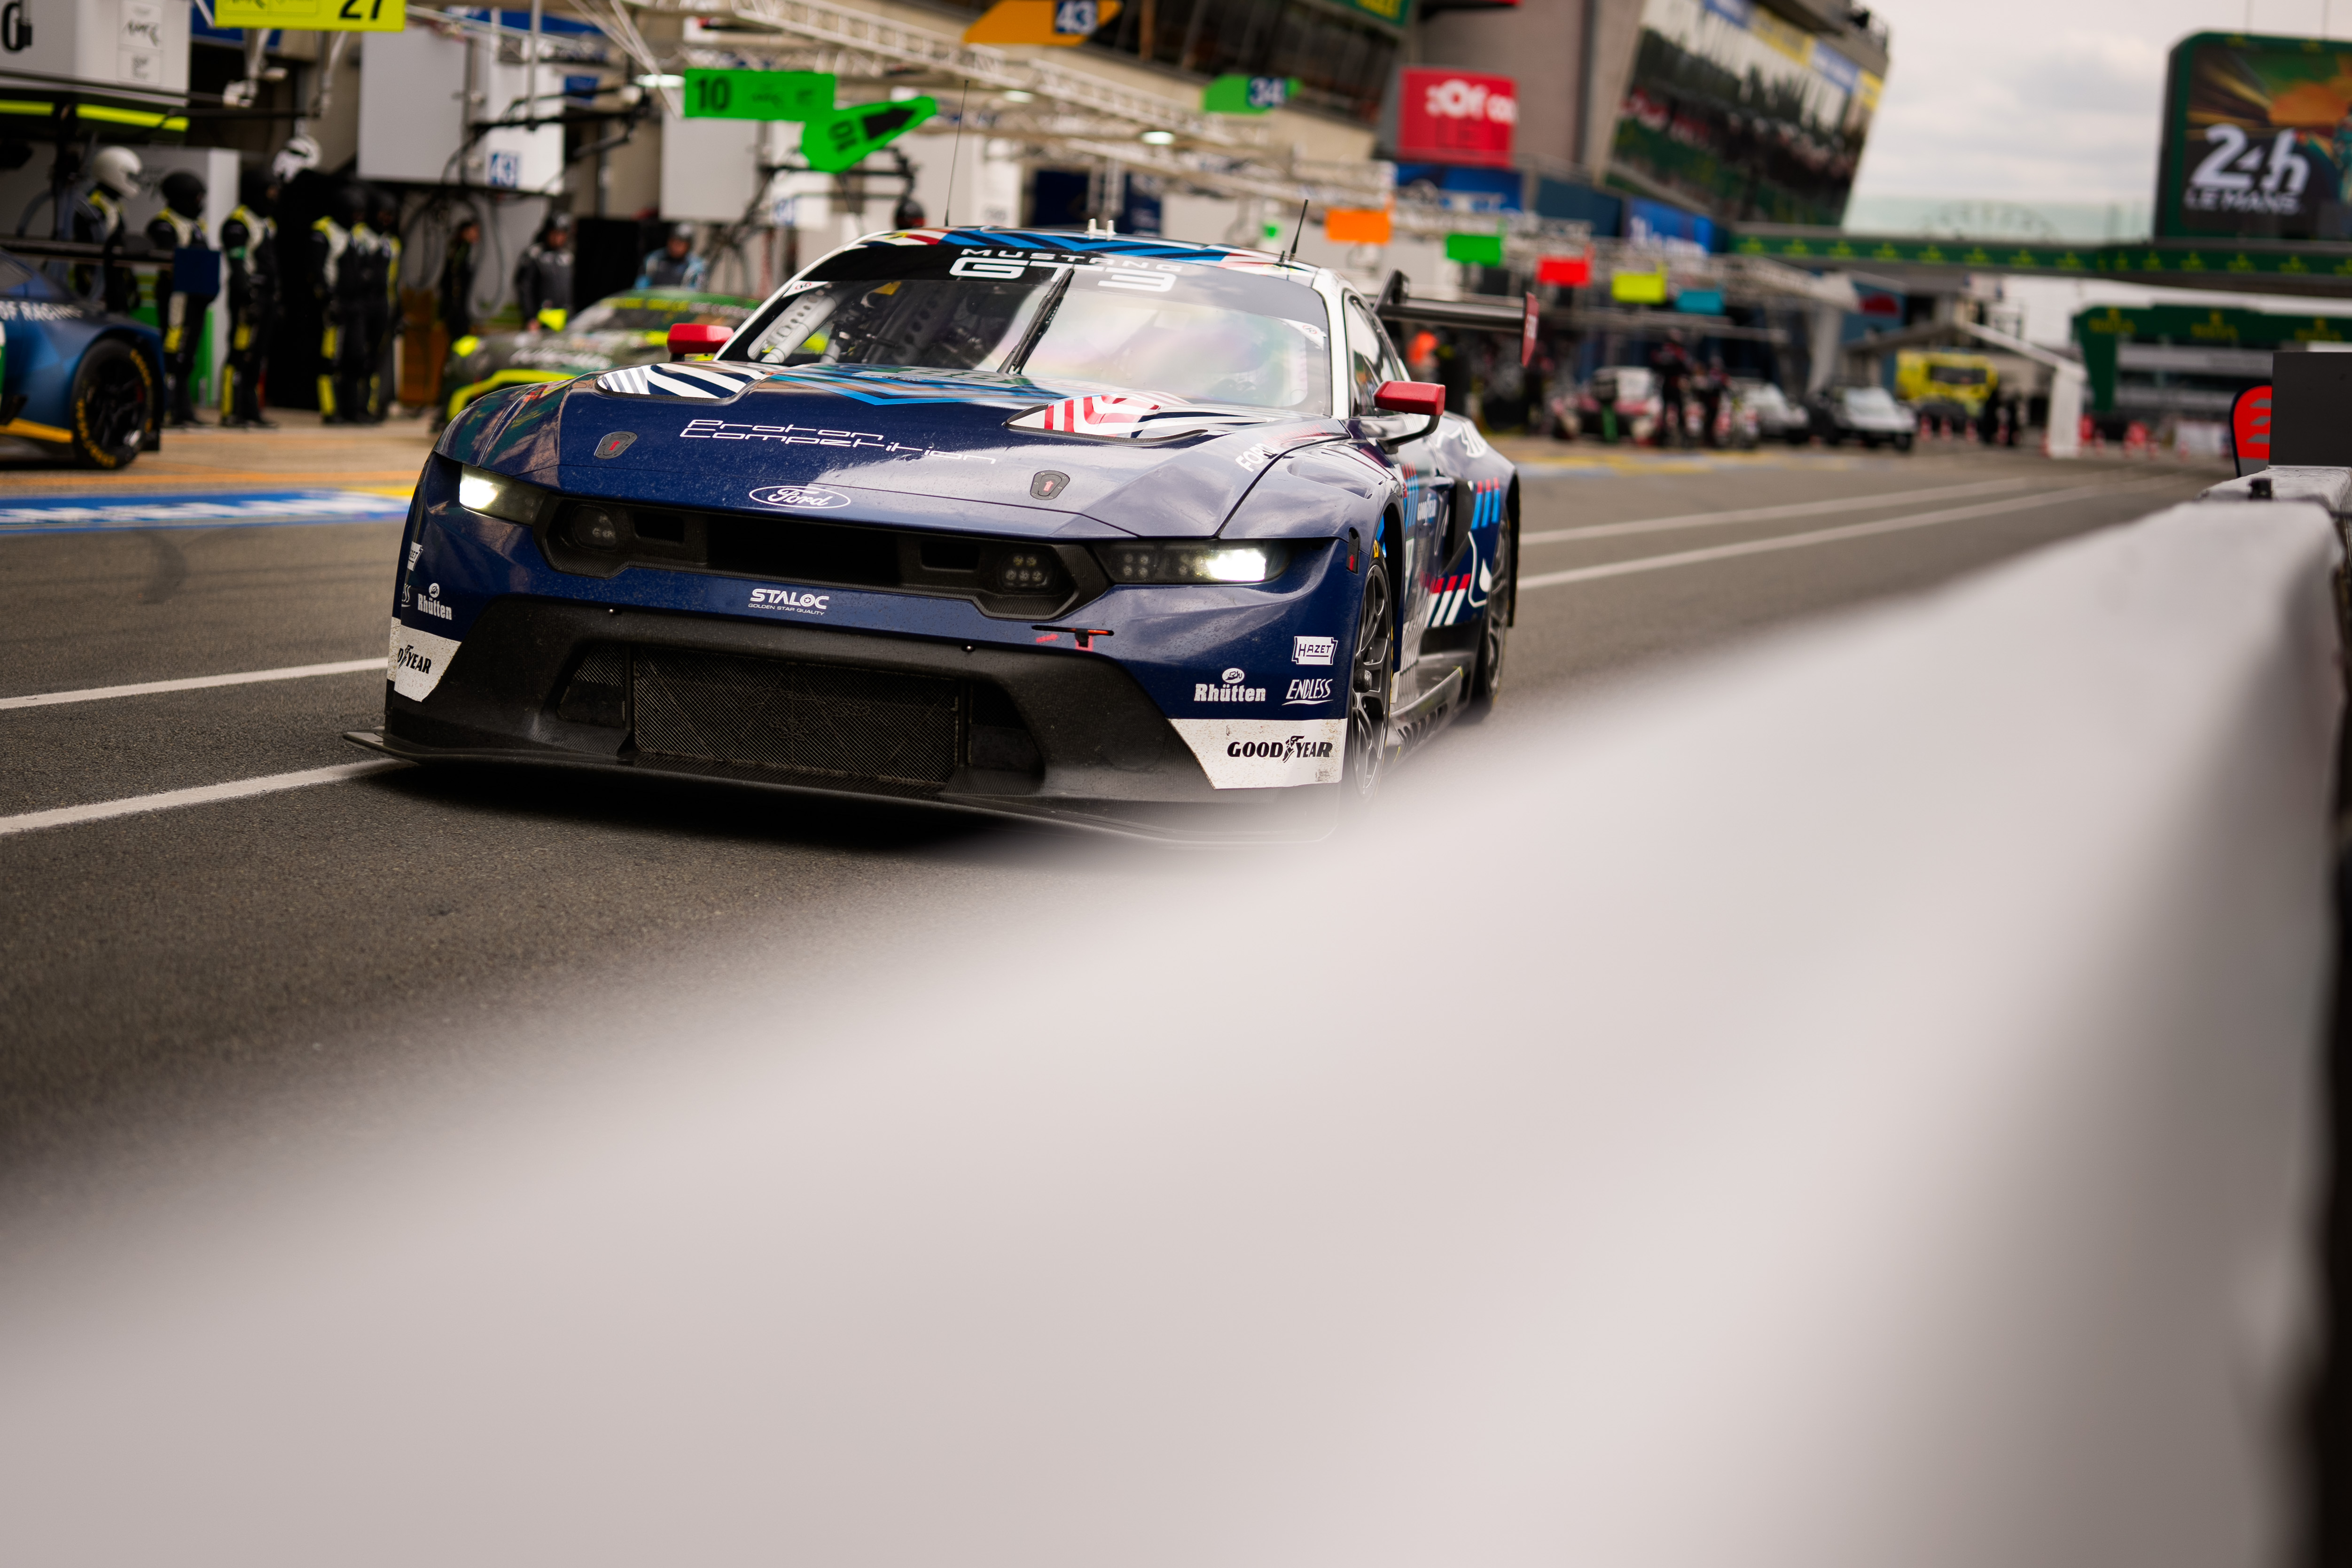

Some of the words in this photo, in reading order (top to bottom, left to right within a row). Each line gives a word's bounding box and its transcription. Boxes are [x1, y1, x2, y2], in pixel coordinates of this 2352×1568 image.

[1056, 0, 1095, 34] 43
[694, 77, 731, 112] 10
[1250, 77, 1285, 107] 34
[828, 119, 858, 152] 10
[961, 249, 1183, 272] MUSTANG
[949, 257, 1176, 292] GT3
[688, 419, 883, 440] Proton
[680, 428, 996, 464] Competition
[1235, 443, 1278, 472] FORD
[767, 488, 833, 506] Ford
[417, 593, 453, 620] Rhütten
[750, 588, 830, 609] STALOC
[1298, 644, 1331, 657] HAZET
[1194, 683, 1266, 702] Rhütten
[1286, 679, 1333, 699] ENDLESS
[1227, 741, 1333, 758] GOODYEAR
